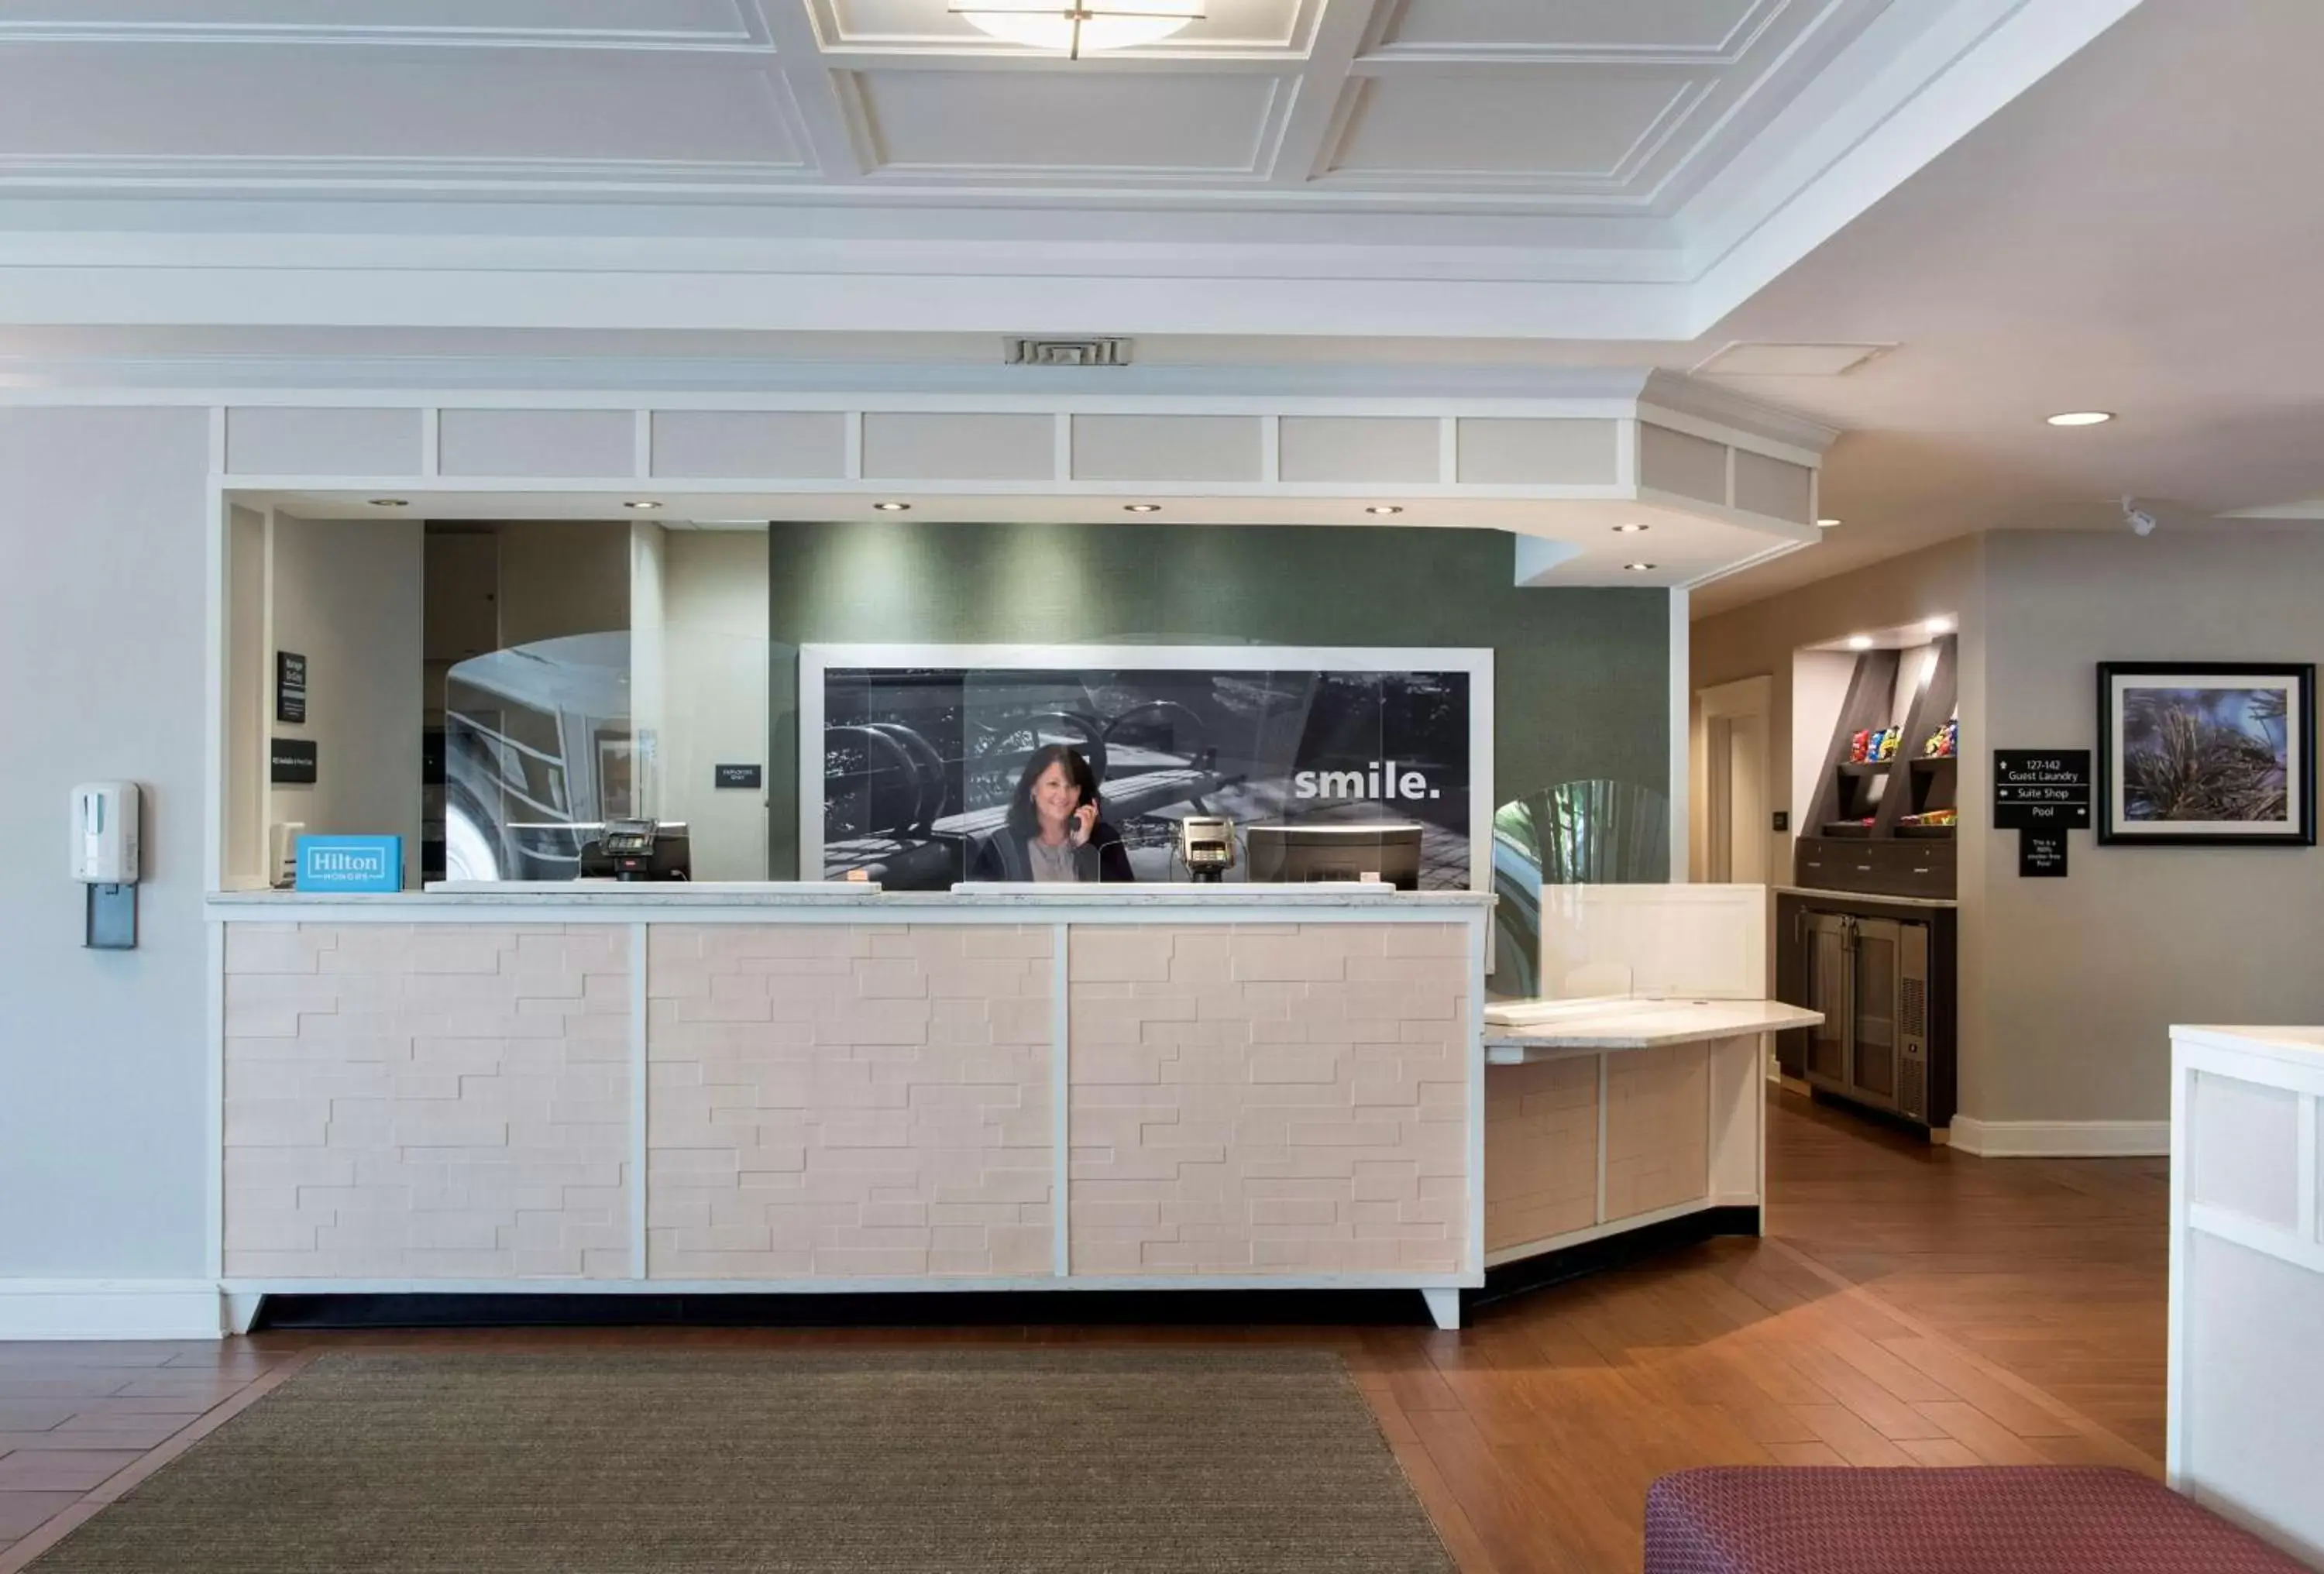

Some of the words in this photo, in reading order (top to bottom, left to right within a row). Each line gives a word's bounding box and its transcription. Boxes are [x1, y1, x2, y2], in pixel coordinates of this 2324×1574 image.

[2027, 760, 2061, 770] 127-142
[1294, 761, 1440, 799] smile.
[2009, 771, 2037, 782] Guest
[2038, 771, 2078, 783] Laundry
[2017, 788, 2042, 799] Suite
[2044, 788, 2069, 800] Shop
[2032, 806, 2054, 816] Pool
[315, 852, 378, 870] Hilton
